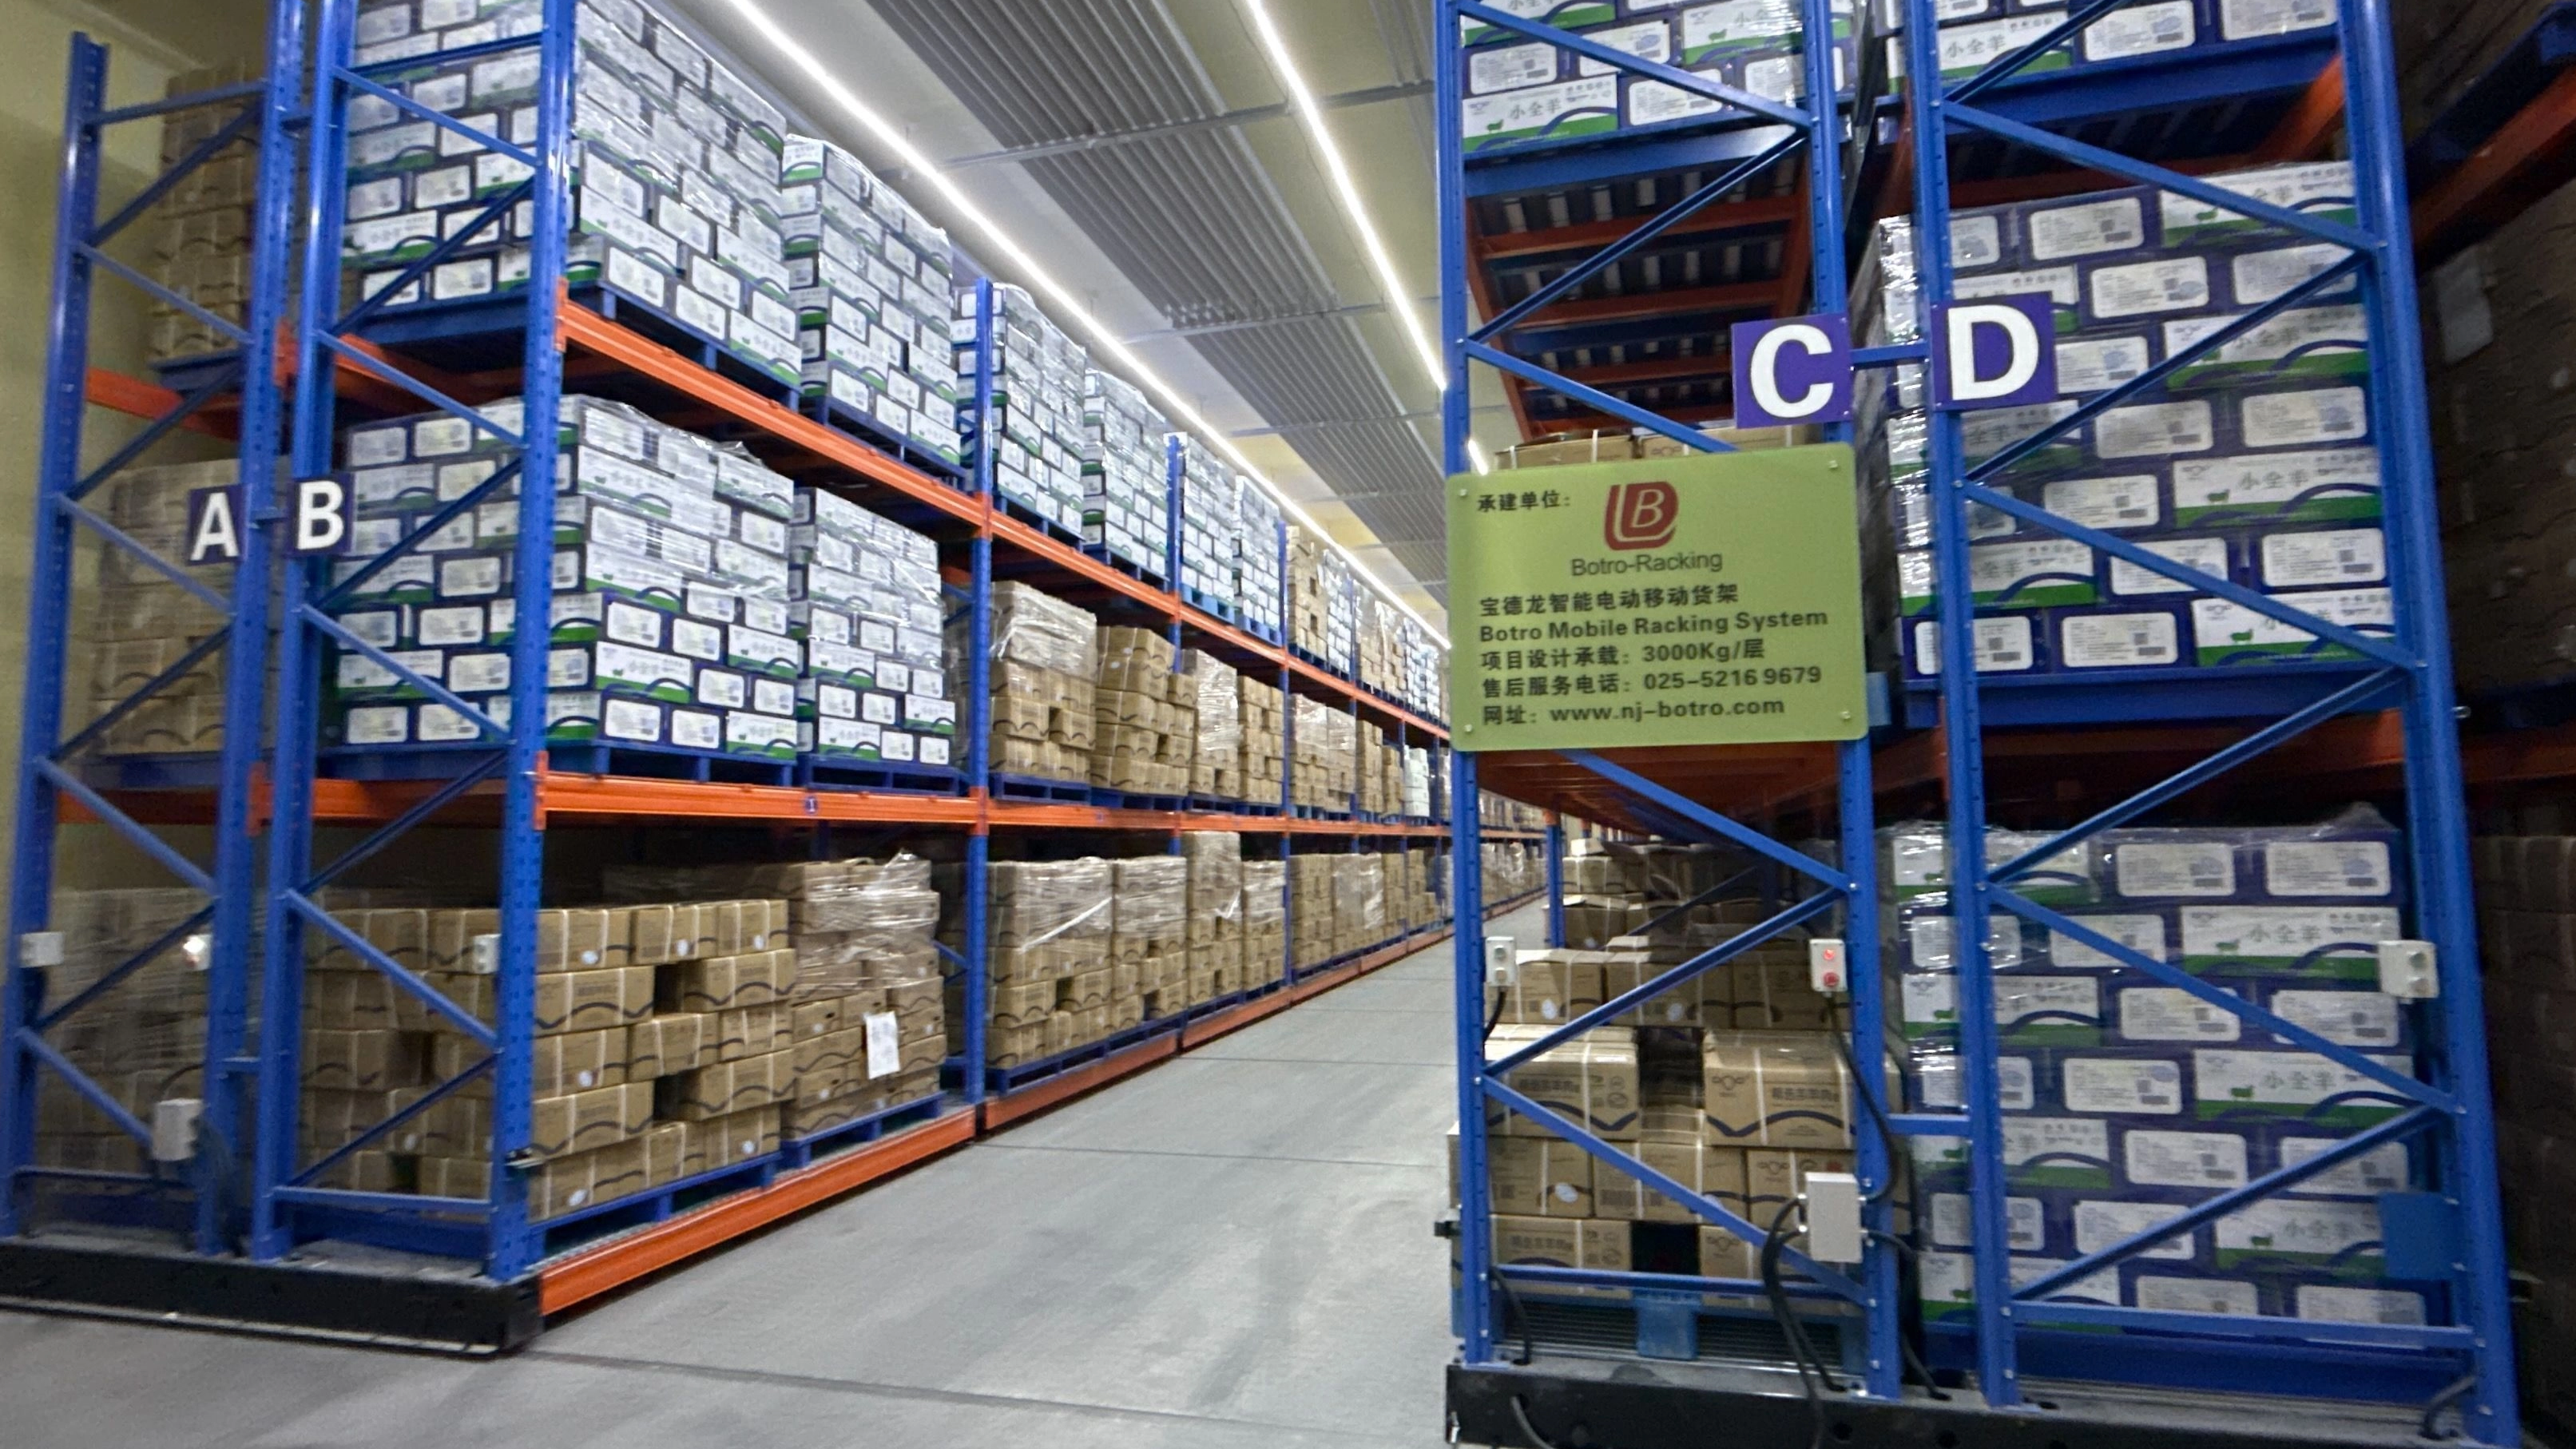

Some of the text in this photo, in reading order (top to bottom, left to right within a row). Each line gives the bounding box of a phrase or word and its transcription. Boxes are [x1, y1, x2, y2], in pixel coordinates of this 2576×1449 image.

[1947, 304, 2039, 400] D
[1751, 324, 1834, 418] C
[296, 480, 344, 550] B
[1478, 490, 1570, 513] 承建单位：
[190, 492, 240, 561] A
[1571, 552, 1723, 577] Botro-Racking
[1479, 583, 1739, 617] 宝德龙智能电动移动货架
[1480, 610, 1828, 641] Botro Mobile Racking System
[1641, 638, 1765, 662] 3000Kg/层
[1550, 700, 1784, 722] www.nj-botro.com
